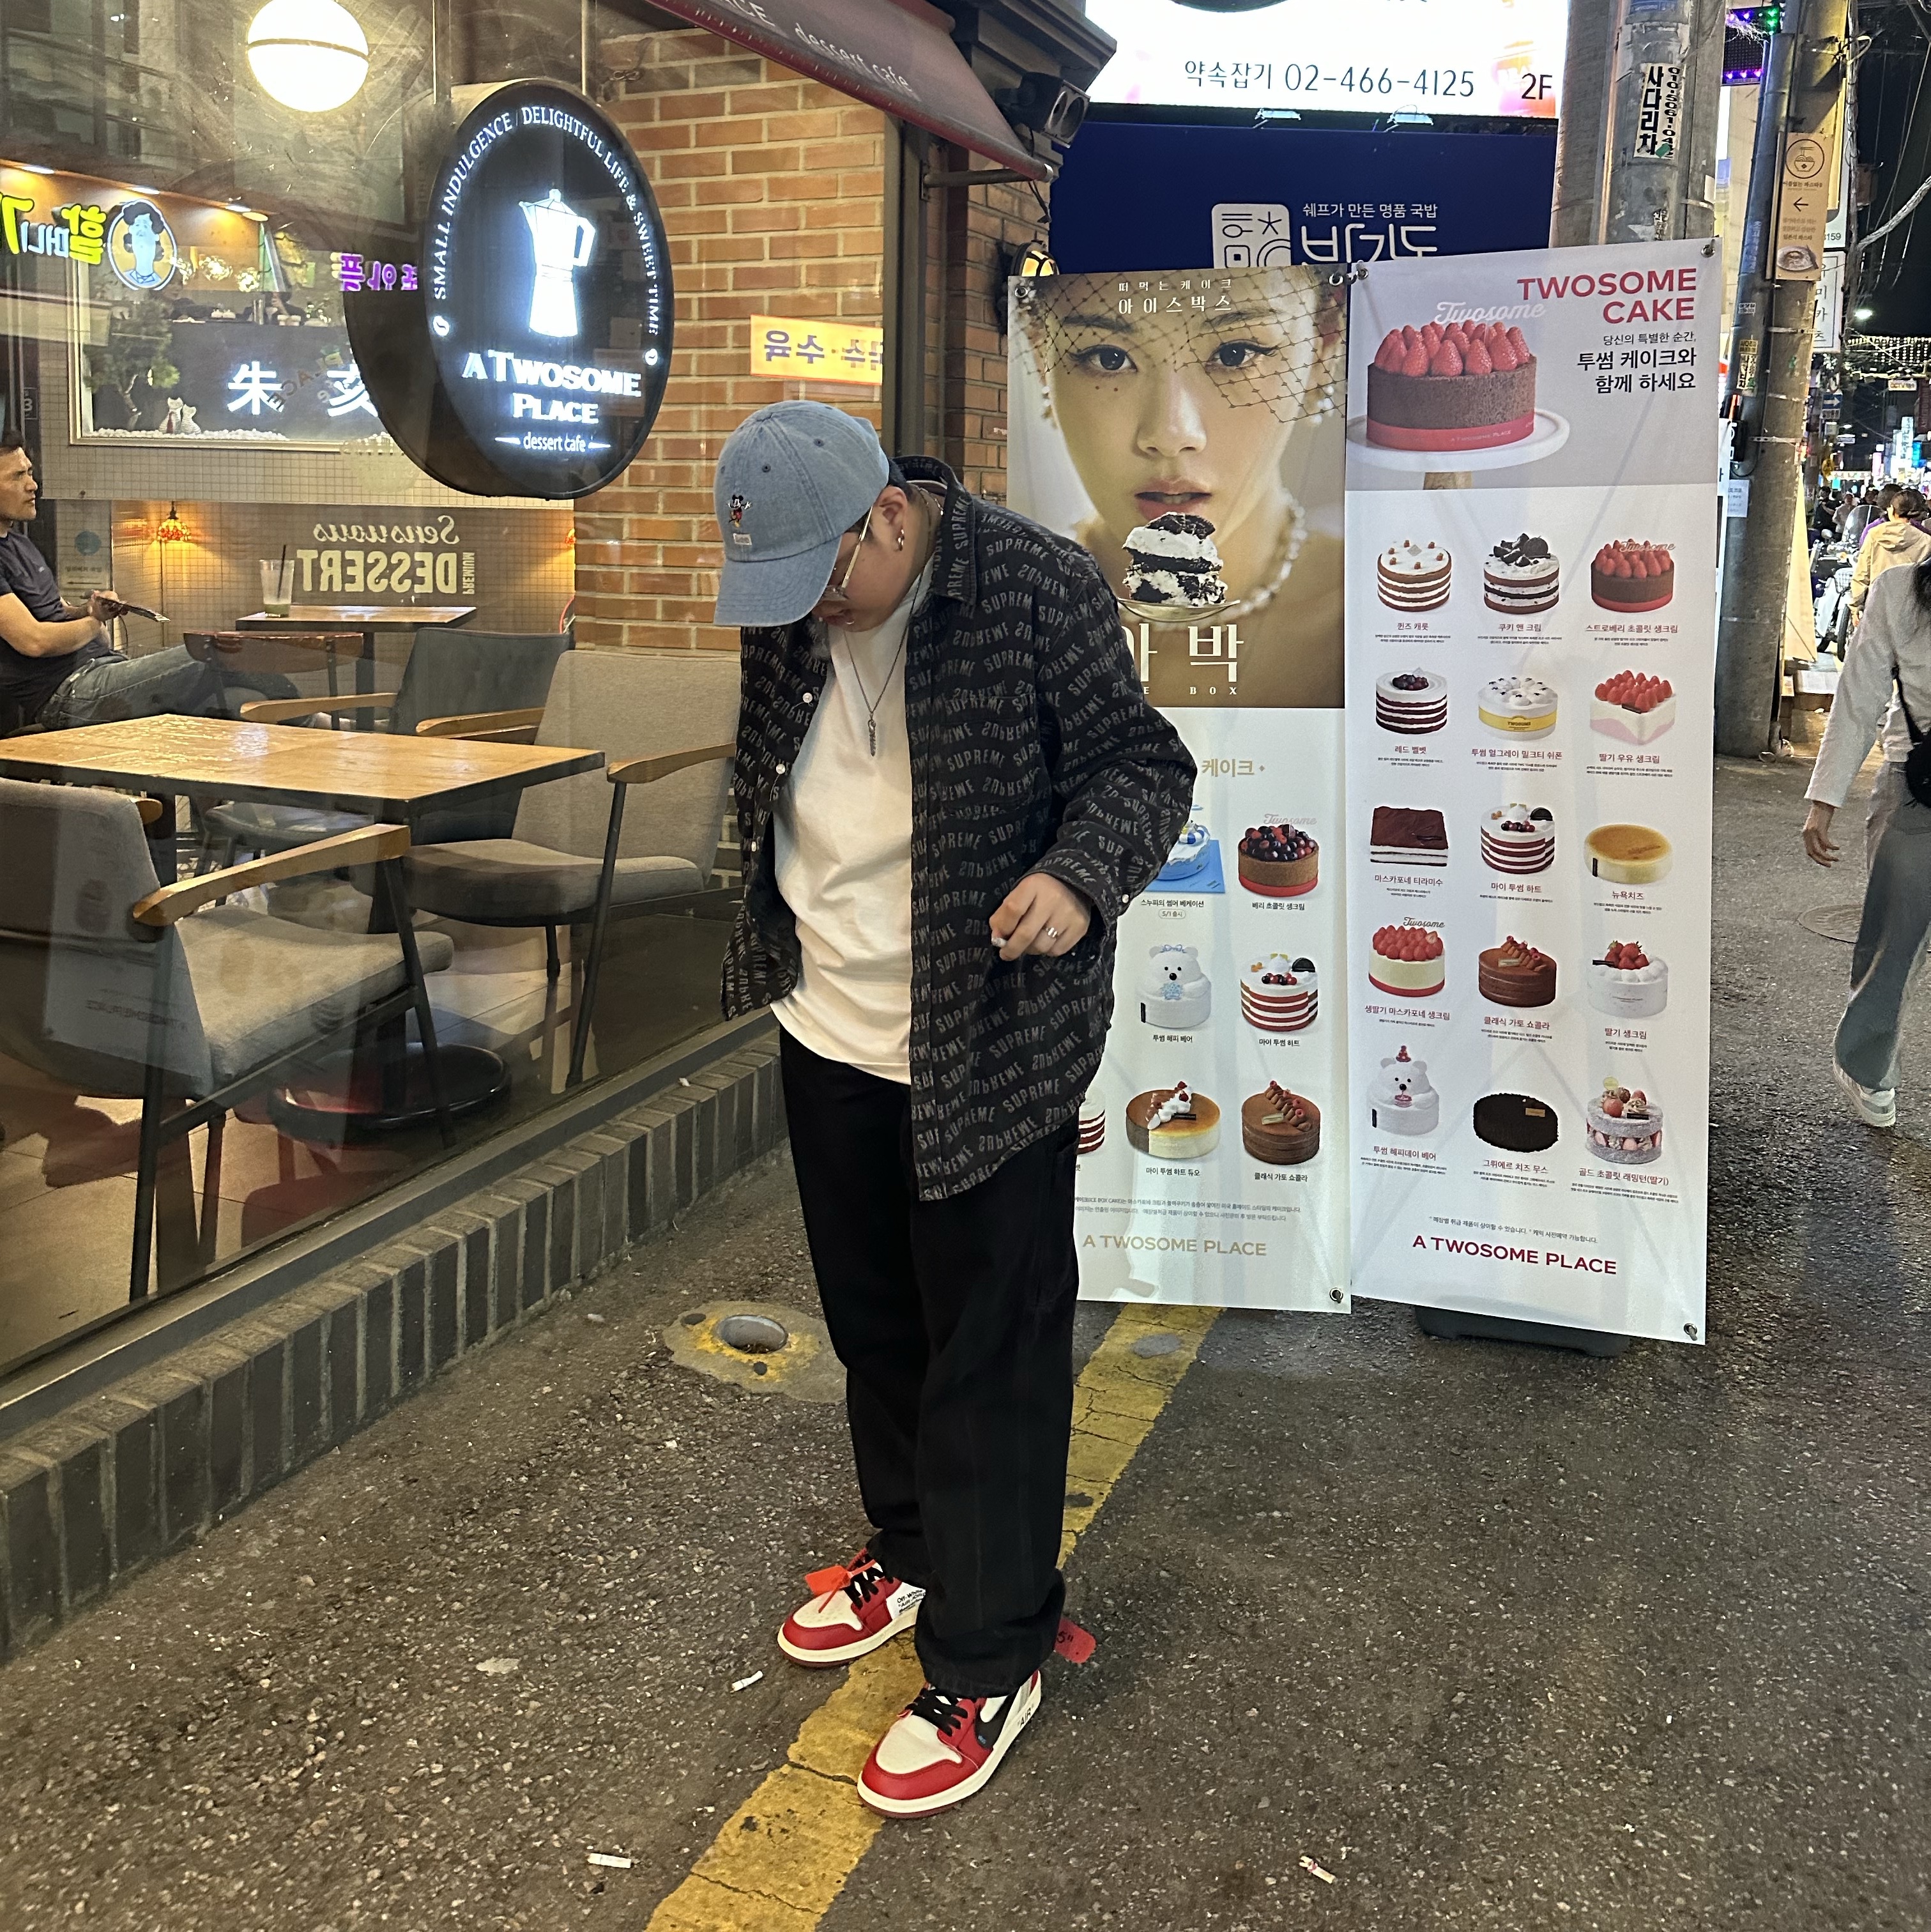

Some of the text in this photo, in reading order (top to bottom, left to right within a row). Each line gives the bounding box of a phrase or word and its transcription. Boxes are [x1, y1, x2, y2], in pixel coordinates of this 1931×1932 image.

[873, 65, 913, 92] cafe
[1185, 61, 1474, 97] 약속잡기 02-466-4125
[1522, 73, 1553, 100] 2F
[1637, 66, 1663, 155] 사다리차
[521, 106, 603, 158] DELIGHTFUL
[441, 112, 514, 217] INDULGENCE
[603, 151, 630, 193] LIFE
[625, 194, 636, 211] &
[1302, 203, 1438, 218] 쉐프가 만든 명품 국밥
[633, 211, 659, 280] SWEET
[434, 222, 450, 300] SMALL
[1517, 268, 1697, 300] TWOSOME
[1118, 295, 1232, 314] 아이스박스
[1434, 300, 1546, 325] Twosome
[1603, 297, 1695, 324] CAKE
[1603, 331, 1697, 346] 당신의 특별한 순간,
[1576, 348, 1697, 371] 투썸 케이크와
[461, 349, 642, 397] A TWOSOME
[1596, 372, 1696, 394] 함께 하세요
[512, 392, 599, 424] PLACE
[523, 431, 587, 452] dessert cafe
[981, 593, 1033, 614] SUPREM
[1585, 624, 1625, 632] 스트로베리
[1654, 625, 1678, 633] 생크림
[1189, 687, 1238, 695] BOX
[1394, 746, 1409, 754] 레드
[1472, 748, 1486, 757] 투썸
[1522, 750, 1545, 759] 밀크티
[1547, 751, 1562, 760] 쉬폰
[1599, 753, 1660, 763] 딸기 우유 생크림
[1202, 758, 1255, 778] 케이크
[1375, 874, 1443, 887] 마스카포네 티라미수
[1491, 882, 1542, 893] 마이 투썸 하트
[1612, 890, 1644, 900] 뉴욕치즈
[1403, 916, 1445, 928] Twosome
[1365, 1005, 1450, 1020] 생딸기 마스카포네 생크림
[1605, 1027, 1647, 1039] 딸기 생크림
[1160, 1167, 1173, 1176] 투썸
[1173, 1168, 1186, 1176] 하트
[1187, 1169, 1201, 1177] 듀오
[1274, 1172, 1287, 1181] 가토
[1515, 1162, 1530, 1172] 치즈
[1533, 1165, 1548, 1174] 무스
[1578, 1167, 1594, 1177] 골드
[1083, 1234, 1267, 1256] A TWOSOME PLACE
[1412, 1235, 1617, 1275] A TWOSOME PLACE
